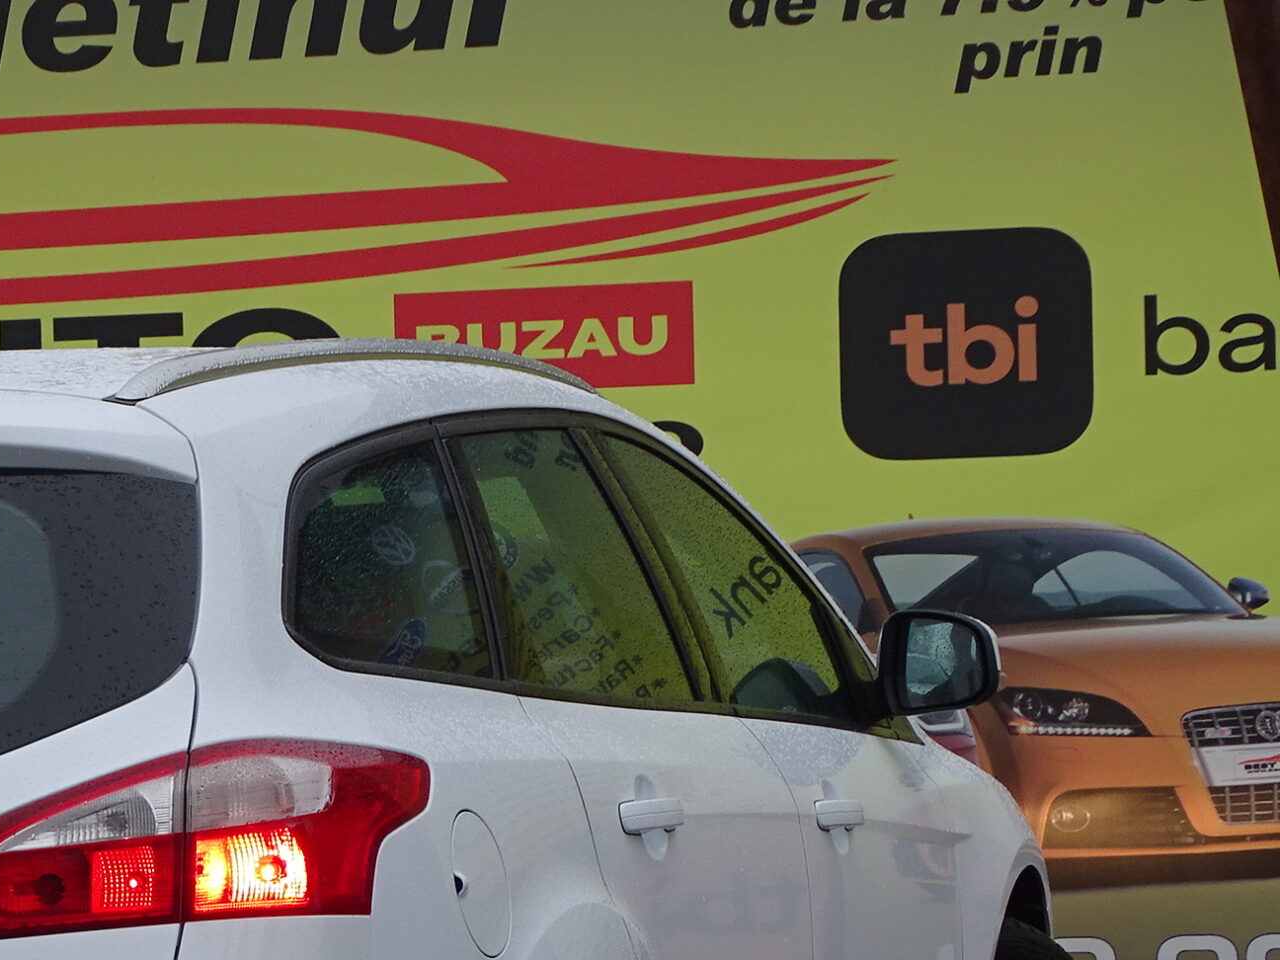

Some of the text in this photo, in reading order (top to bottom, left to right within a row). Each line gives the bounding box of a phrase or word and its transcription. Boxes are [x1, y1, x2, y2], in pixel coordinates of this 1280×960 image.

[954, 25, 1103, 94] prin
[889, 294, 1277, 388] tbi ba
